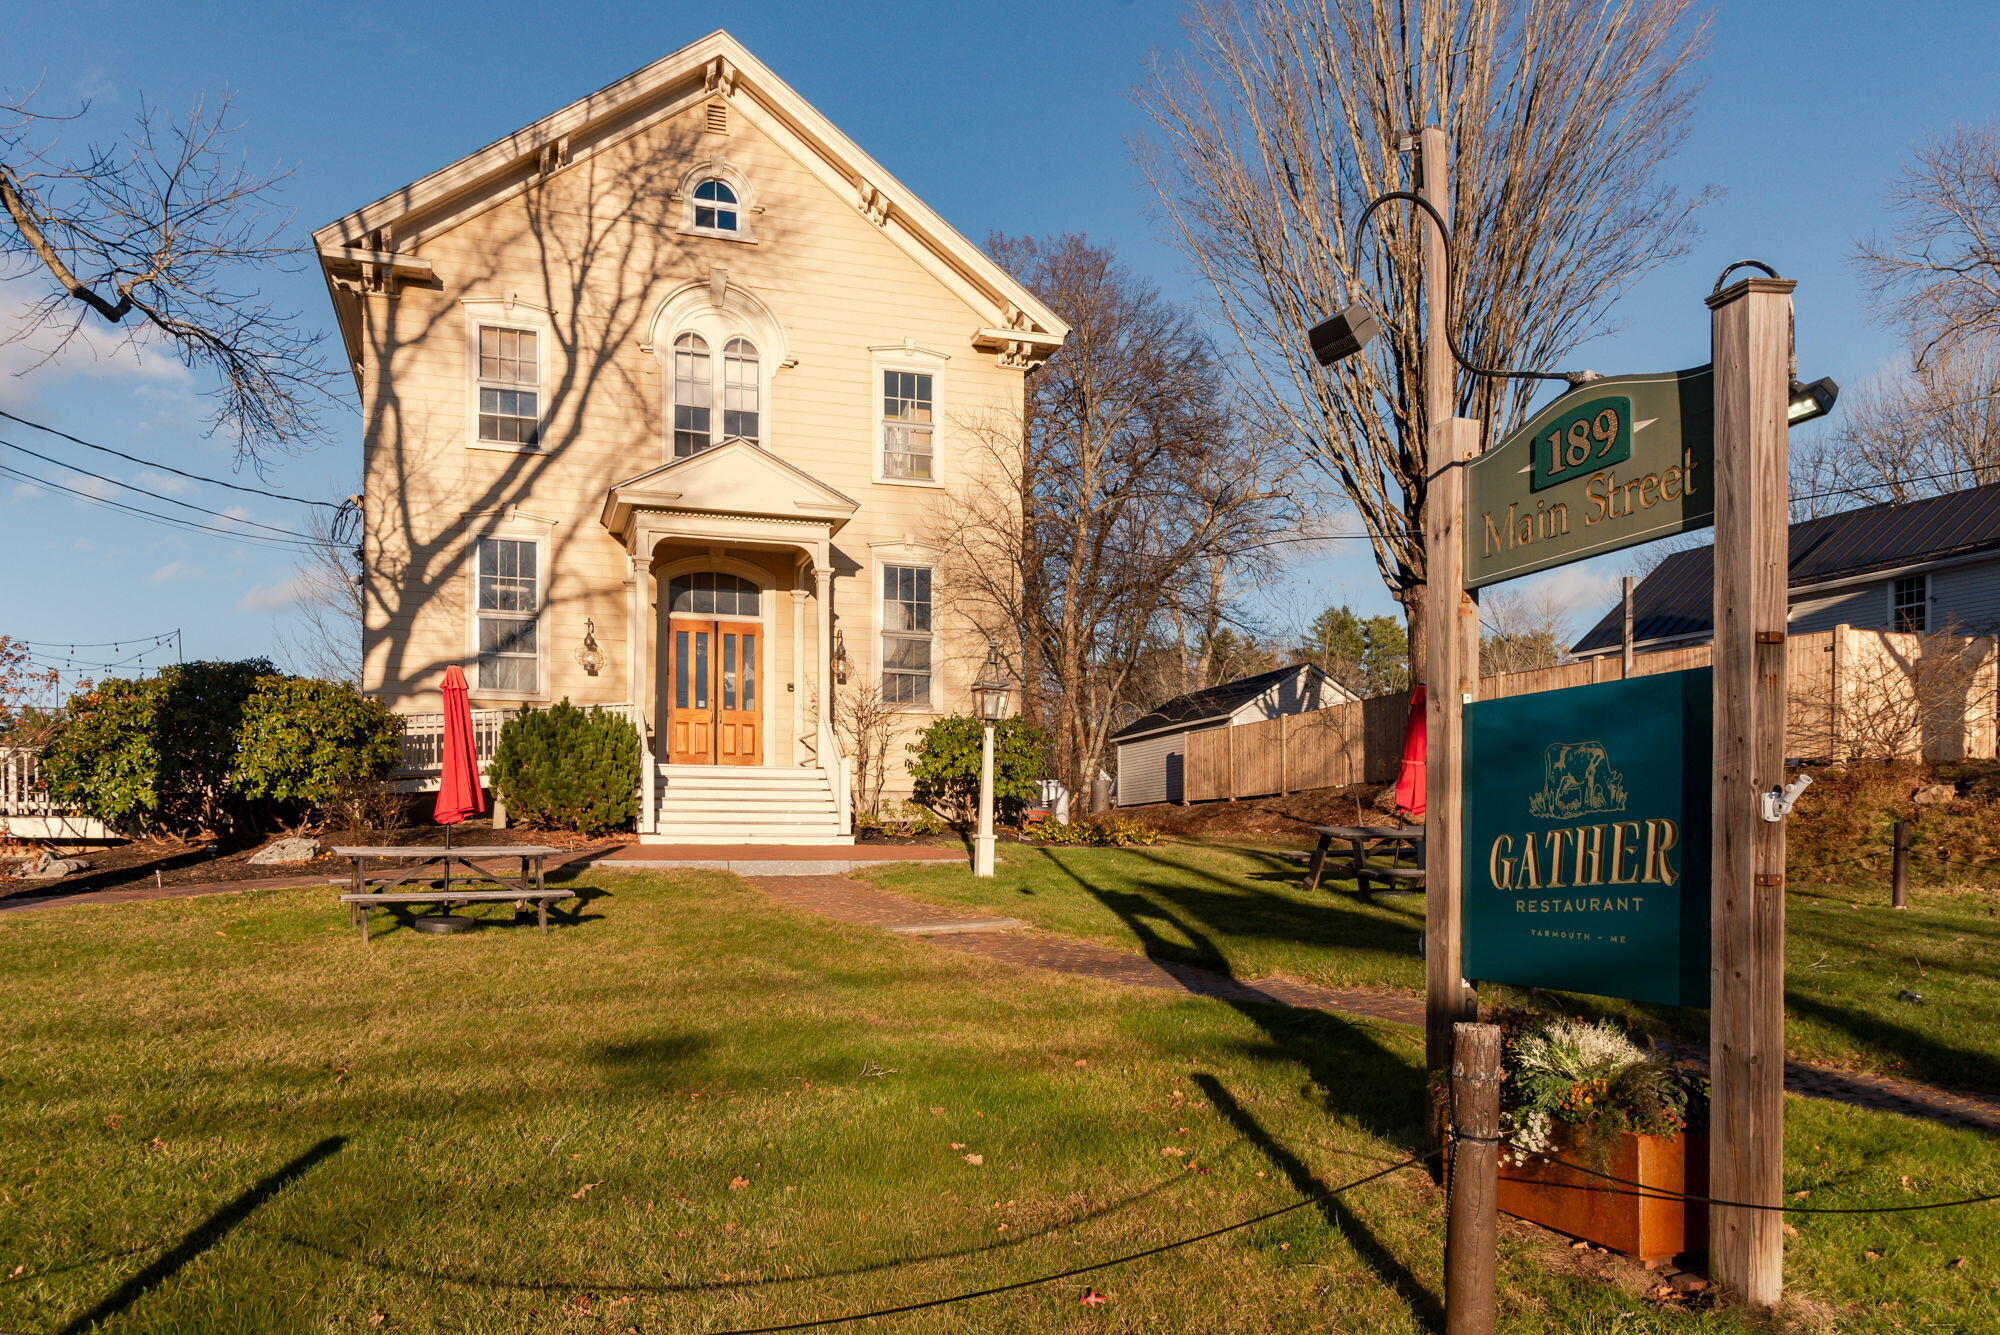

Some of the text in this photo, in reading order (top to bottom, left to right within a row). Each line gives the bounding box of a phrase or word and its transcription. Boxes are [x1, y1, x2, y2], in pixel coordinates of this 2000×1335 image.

[1546, 408, 1619, 476] 189
[1482, 447, 1698, 559] Main Street
[1489, 818, 1680, 891] GATHER
[1516, 897, 1644, 913] RESTAURANT
[1530, 929, 1591, 940] YARMOUTH
[1609, 935, 1627, 943] ME
